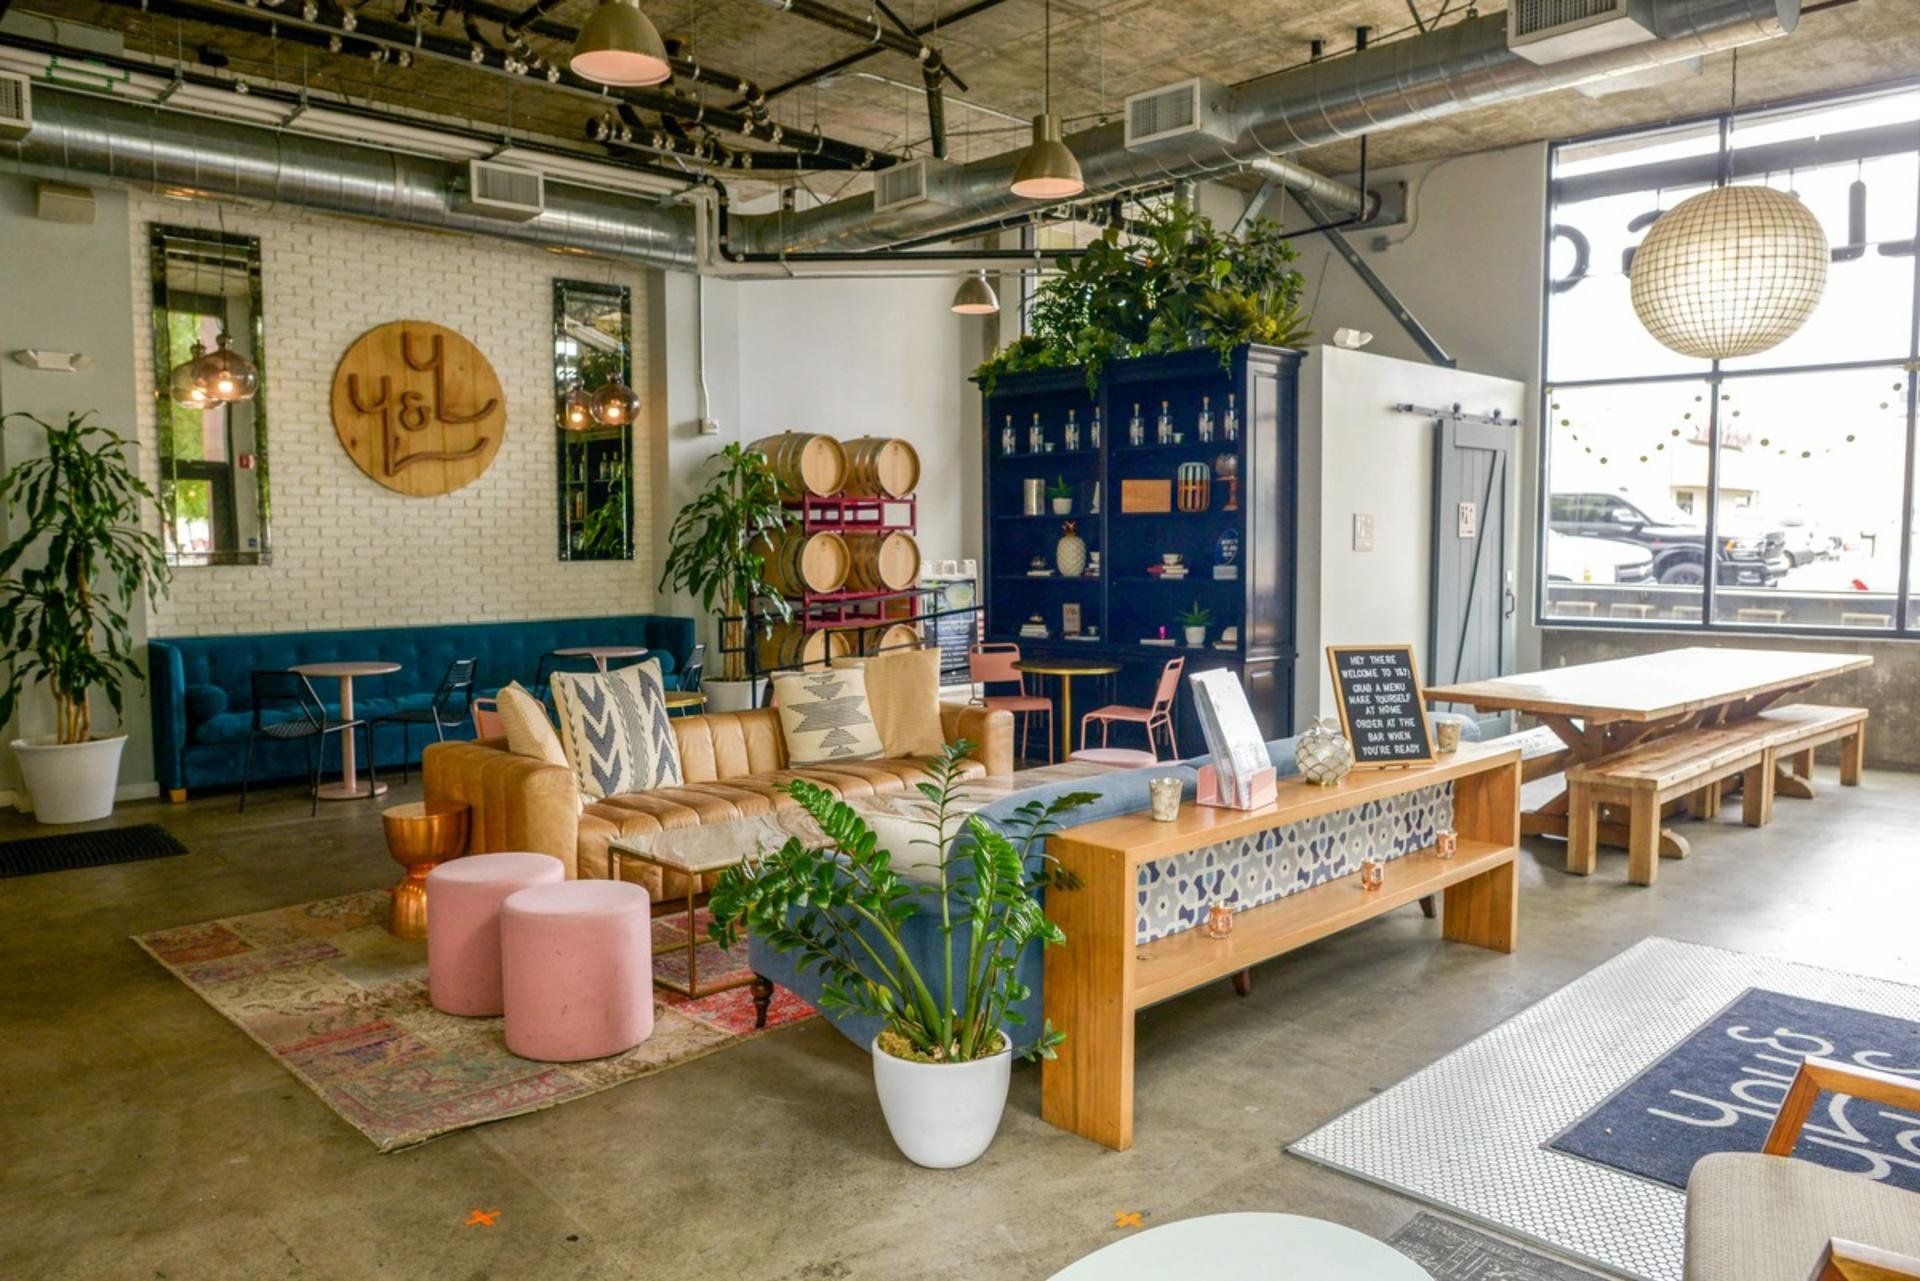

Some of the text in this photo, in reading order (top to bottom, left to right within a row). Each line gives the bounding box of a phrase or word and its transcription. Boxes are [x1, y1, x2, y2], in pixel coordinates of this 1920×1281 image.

[1350, 654, 1397, 666] HEY THERE
[1341, 668, 1379, 679] WELCOME
[1381, 668, 1391, 677] TO
[1352, 682, 1406, 693] GRAB A MENU
[1348, 693, 1411, 704] MAKE YOURSELF
[1365, 704, 1402, 715] AT HOME
[1355, 717, 1416, 729] ORDER AT THE
[1367, 731, 1412, 742] BAR WHEN
[1361, 743, 1420, 756] YOU'RE READY
